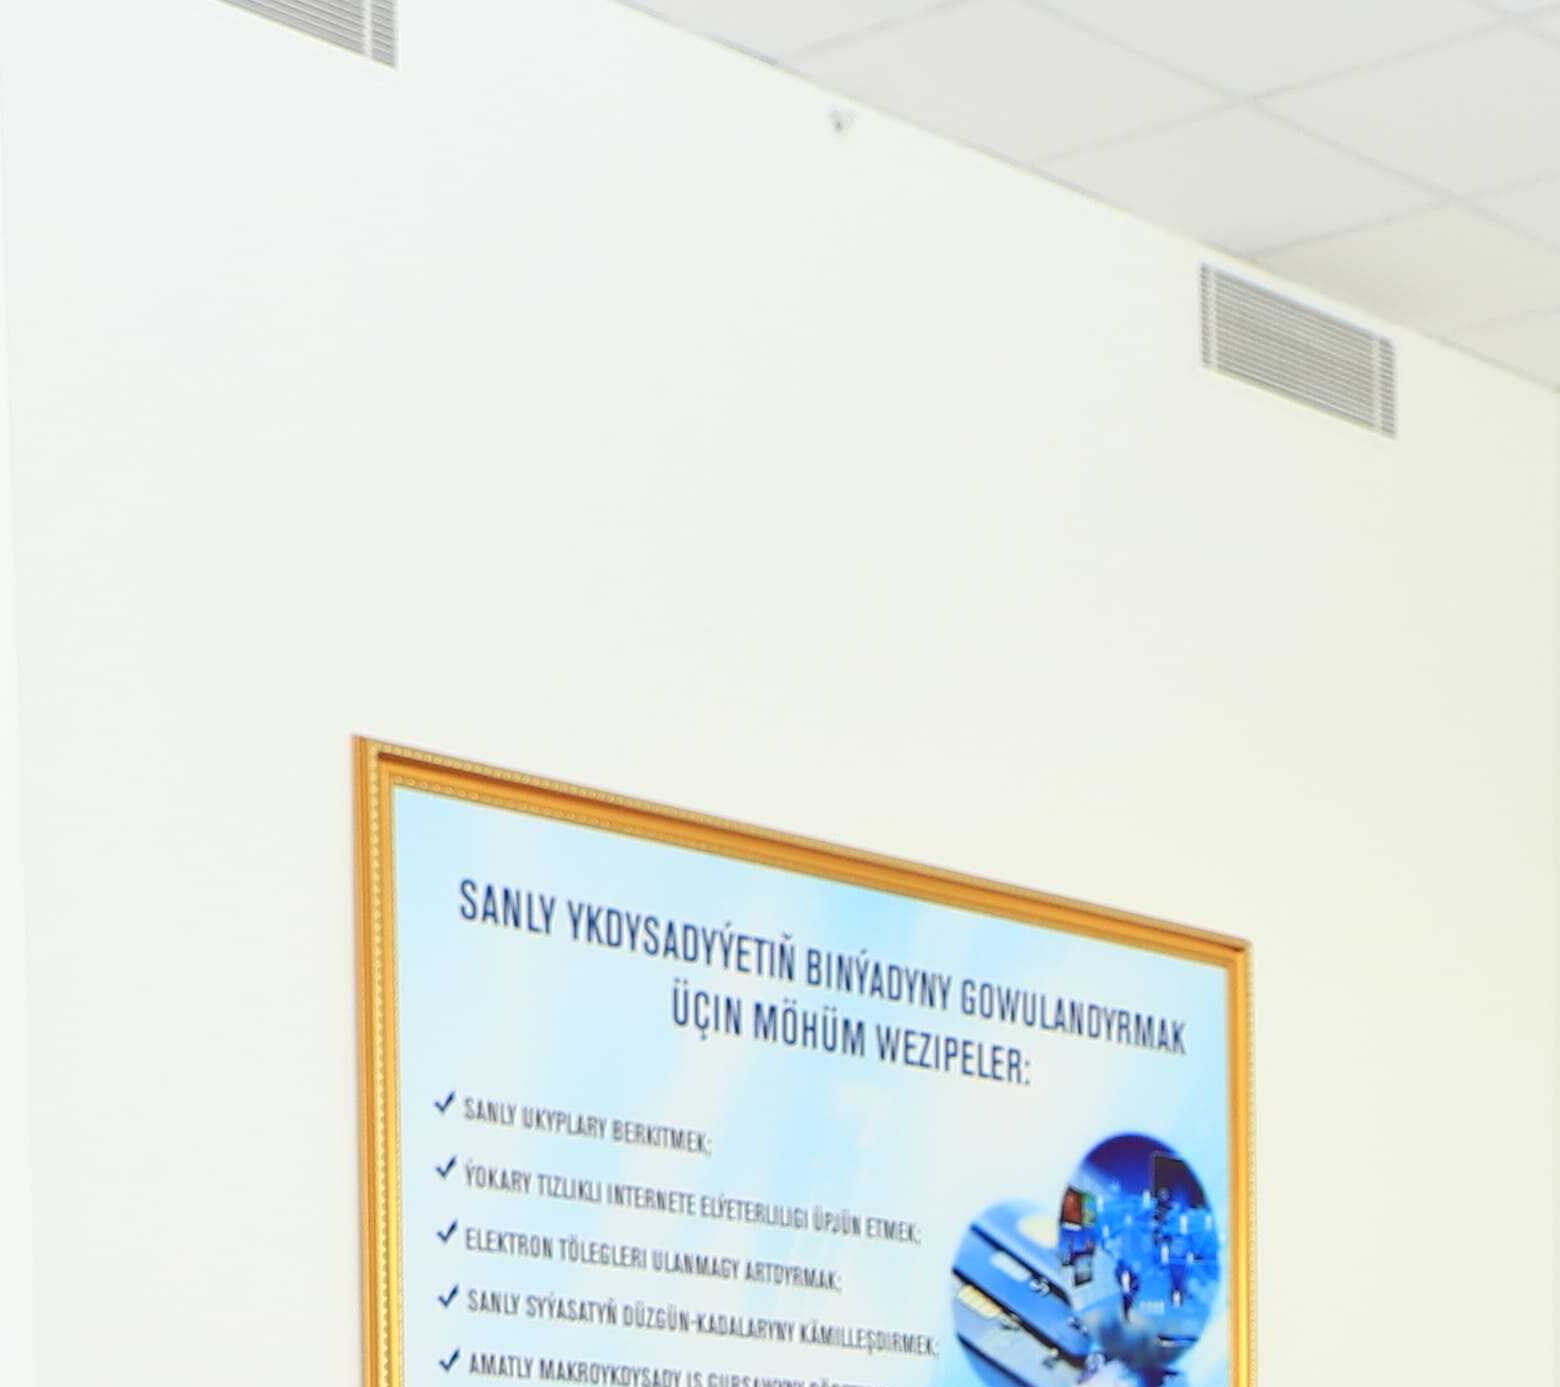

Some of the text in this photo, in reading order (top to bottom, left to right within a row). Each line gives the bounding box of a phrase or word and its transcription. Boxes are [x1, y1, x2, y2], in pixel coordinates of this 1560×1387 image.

[459, 879, 1188, 1055] SANLY YKDYSADYÝETIŇ BINÝADYNY GOWULANDYRMAK
[672, 977, 1033, 1086] ÜÇIN MÖHÜM WEZIPELER:
[464, 1097, 518, 1125] SANLY
[521, 1106, 608, 1140] UKYPLARY
[464, 1158, 532, 1194] ÝOKARY
[537, 1172, 602, 1203] TIZLIKLI
[607, 1183, 697, 1216] INTERNETE
[465, 1226, 553, 1259] ELEKTRON
[559, 1233, 647, 1269] TÖLEGLERI
[652, 1249, 740, 1280] ULANMAGY
[468, 1288, 521, 1316] SANLY
[469, 1352, 534, 1379] AMATLY
